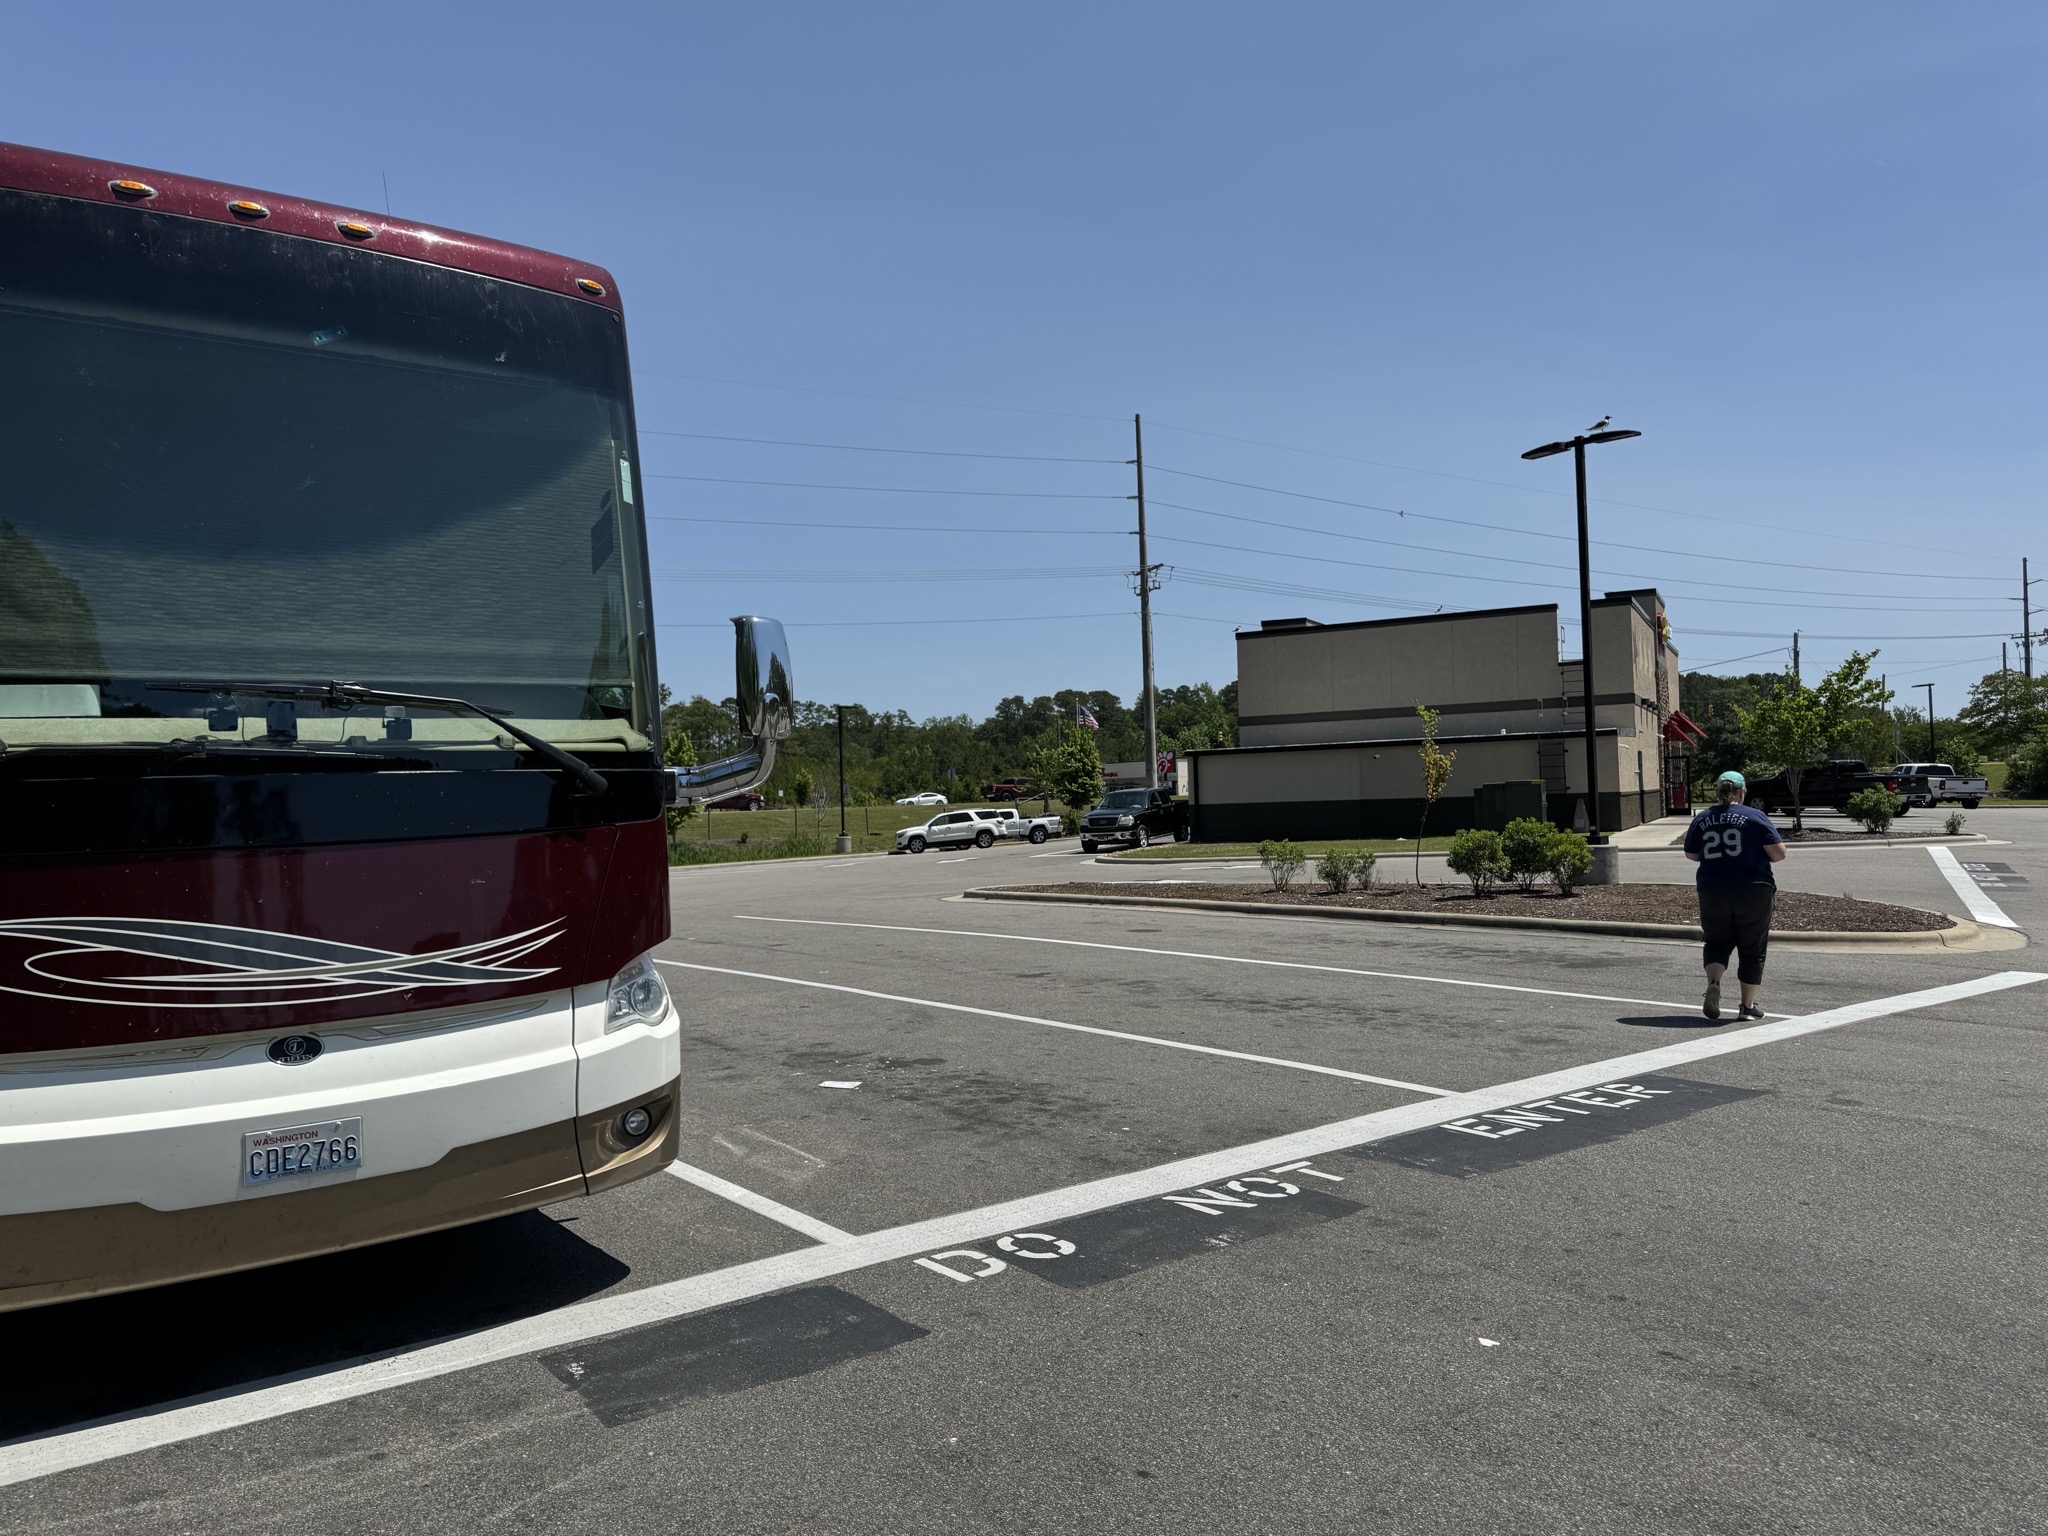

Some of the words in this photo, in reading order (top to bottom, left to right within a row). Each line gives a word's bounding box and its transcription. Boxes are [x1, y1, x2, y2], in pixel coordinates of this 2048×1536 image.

[1699, 813, 1748, 831] RALEIGH
[1703, 828, 1742, 859] 29
[279, 1053, 313, 1063] TIFFIN
[253, 1131, 318, 1147] WASHINGTON
[250, 1135, 358, 1176] CDE2766
[277, 1168, 313, 1179] EVERGREEN
[913, 1233, 1076, 1282] DO
[1162, 1161, 1345, 1215] NOT
[1440, 1083, 1673, 1139] ENTER
